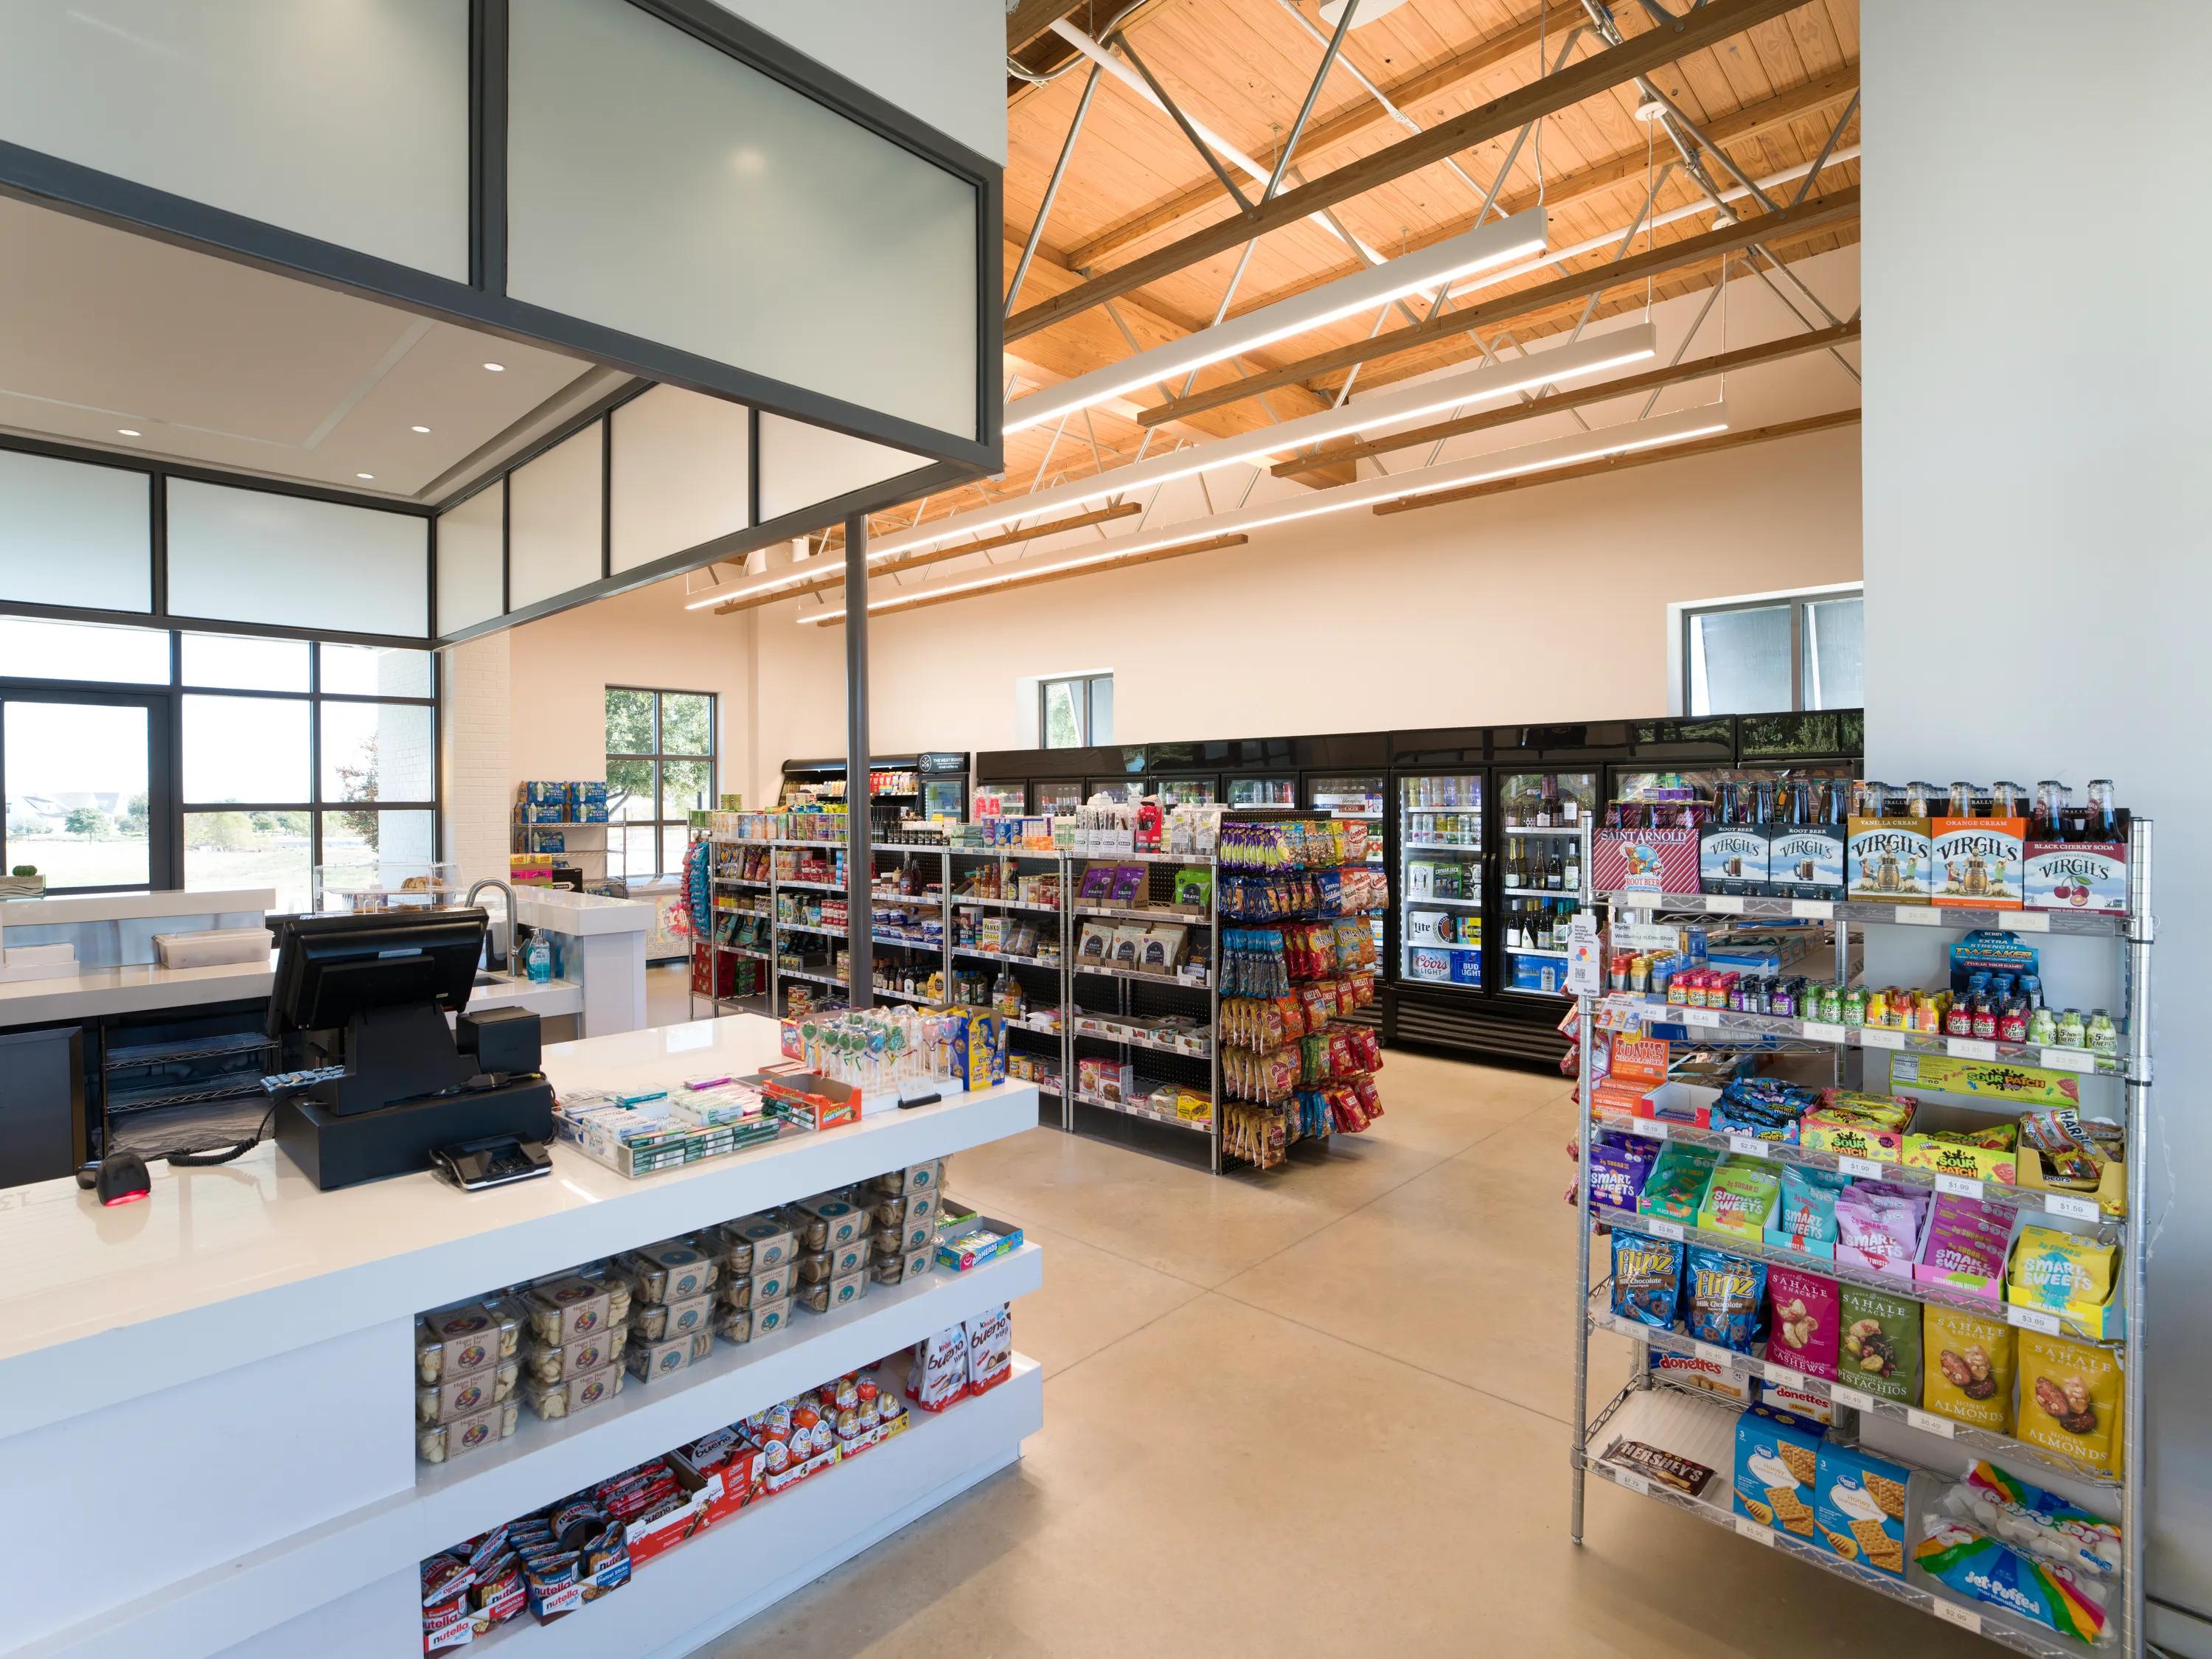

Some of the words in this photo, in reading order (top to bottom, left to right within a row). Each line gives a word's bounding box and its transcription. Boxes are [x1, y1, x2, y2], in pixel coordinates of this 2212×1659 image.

[1351, 827, 1367, 840] Combos
[1601, 830, 1635, 841] SAINT
[1635, 829, 1687, 845] ARNOLD
[1710, 838, 1759, 857] VIRGIL'S
[1780, 841, 1833, 860] VIRGIL'S
[1851, 834, 1927, 858] VIRGIL'S
[1936, 836, 2017, 861] VIRGIL'S
[2039, 858, 2109, 880] VIRGIL'S
[1414, 922, 1430, 932] Lite
[1338, 928, 1357, 944] BUGLES
[1955, 947, 2033, 959] TWEAKER
[1416, 955, 1448, 970] Coors
[1304, 989, 1321, 1000] CHEEZ-IT
[1952, 1018, 1970, 1026] 5-hour
[2093, 1040, 2115, 1048] ENERGY
[2096, 1034, 2114, 1042] 5-hour
[1616, 1038, 1665, 1060] TONY'S
[2056, 1056, 2078, 1065] $3.89
[1967, 1072, 2004, 1084] SOUR
[2005, 1077, 2045, 1088] PATCH
[823, 1107, 841, 1118] Reese's
[1832, 1138, 1865, 1149] SOUR
[1832, 1147, 1867, 1158] PATCH
[1851, 1164, 1870, 1172] $1.99
[1939, 1156, 1976, 1169] SOUR
[1591, 1172, 1631, 1184] SMART
[1938, 1165, 1978, 1178] PATCH
[1590, 1183, 1634, 1196] SWEETS
[1734, 1181, 1752, 1191] SUGAR
[1949, 1182, 1969, 1192] $1.99
[1714, 1190, 1762, 1204] SMART
[1711, 1199, 1764, 1215] SWEETS
[2060, 1203, 2083, 1213] $1.59
[1784, 1209, 1823, 1225] SMART
[1658, 1225, 1674, 1234] $3.89
[1784, 1220, 1823, 1240] SWEETS
[1845, 1233, 1896, 1249] SMART
[972, 1243, 998, 1266] AIRHEADS
[1617, 1248, 1674, 1277] Flipz
[1935, 1249, 1988, 1269] SMART
[1935, 1258, 1994, 1279] SWEETS
[2023, 1258, 2085, 1276] SMART
[1696, 1268, 1757, 1301] Flipz
[1772, 1274, 1827, 1298] SAHALE
[2023, 1271, 2092, 1292] SWEETS
[1783, 1286, 1816, 1299] SNACKS
[1843, 1295, 1905, 1315] SAHALE
[1855, 1305, 1893, 1318] SNACKS
[1937, 1318, 2006, 1338] SAHALE
[2022, 1315, 2044, 1326] $3.89
[971, 1318, 1006, 1349] bueno
[1952, 1329, 1992, 1342] SNACKS
[939, 1340, 951, 1353] kinder
[928, 1340, 963, 1370] bueno
[1706, 1351, 1722, 1359] $6.49
[1774, 1347, 1826, 1374] CASHEWS
[2035, 1345, 2111, 1372] SAHALE
[1659, 1354, 1722, 1375] donettes
[2050, 1357, 2096, 1374] SNACKS
[1775, 1371, 1792, 1382] $6.49
[1837, 1368, 1907, 1395] PISTACHIOS
[1776, 1388, 1829, 1408] donettes
[1843, 1394, 1861, 1404] $6.49
[1955, 1399, 1986, 1411] HONEY
[1935, 1400, 2004, 1422] ALMONDS
[1921, 1418, 1941, 1429] $6.49
[2029, 1429, 2107, 1460] ALMONDS
[2050, 1430, 2084, 1446] HONEY
[695, 1435, 731, 1458] bueno
[1622, 1441, 1703, 1481] HERSHEY'S
[1764, 1462, 1786, 1476] Honey
[615, 1478, 643, 1497] bueno
[1624, 1478, 1639, 1486] $7.79
[1847, 1494, 1871, 1507] Honey
[519, 1531, 543, 1540] nutella
[538, 1555, 562, 1564] nutella
[544, 1575, 559, 1585] Pretzel
[559, 1572, 571, 1581] Sticks
[597, 1573, 613, 1585] Pretzel
[614, 1566, 627, 1576] Sticks
[534, 1580, 571, 1597] nutella
[1964, 1571, 2039, 1615] Jet-Puffed
[495, 1596, 525, 1613] Breadsticks
[547, 1588, 578, 1609] nutella
[1977, 1587, 2026, 1613] marshmallows
[424, 1615, 457, 1629] utella
[1946, 1608, 1967, 1622] $2.99
[433, 1621, 469, 1644] nutella
